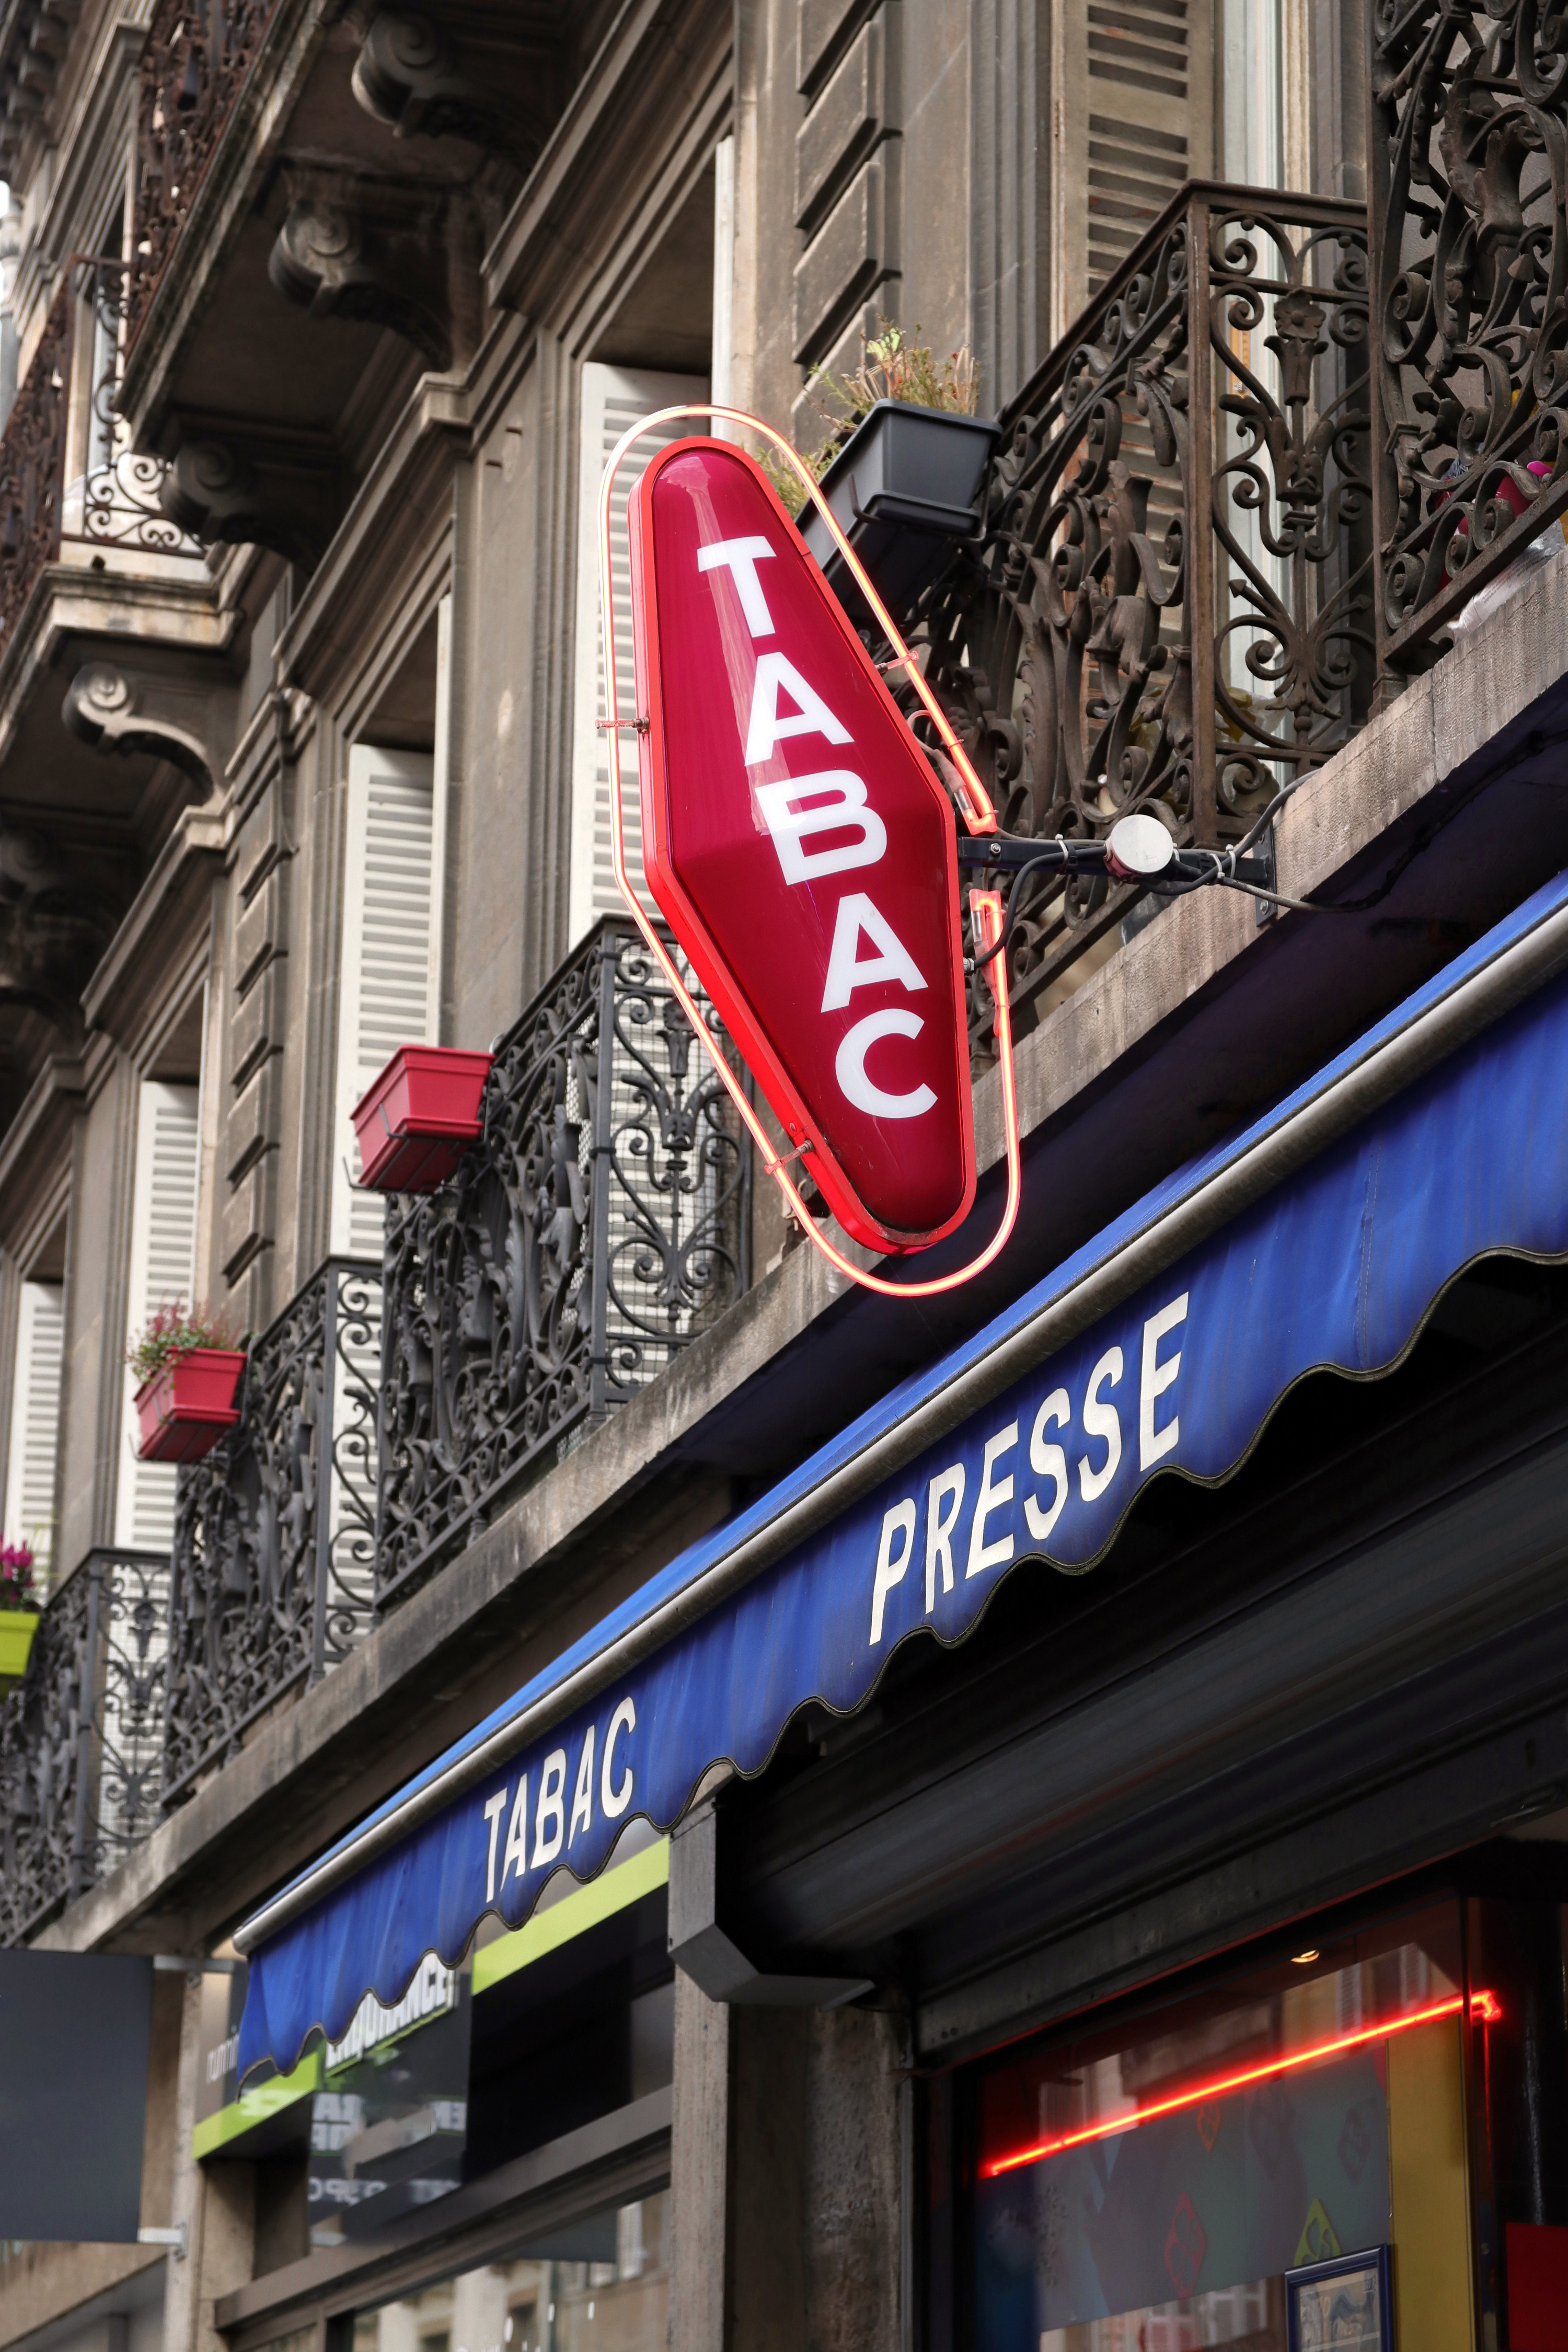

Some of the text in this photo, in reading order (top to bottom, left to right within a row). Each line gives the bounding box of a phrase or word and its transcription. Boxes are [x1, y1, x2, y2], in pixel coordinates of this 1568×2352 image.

[697, 536, 938, 1119] TABAC
[869, 1292, 1189, 1645] PRESSE
[484, 1697, 636, 1903] TABAC
